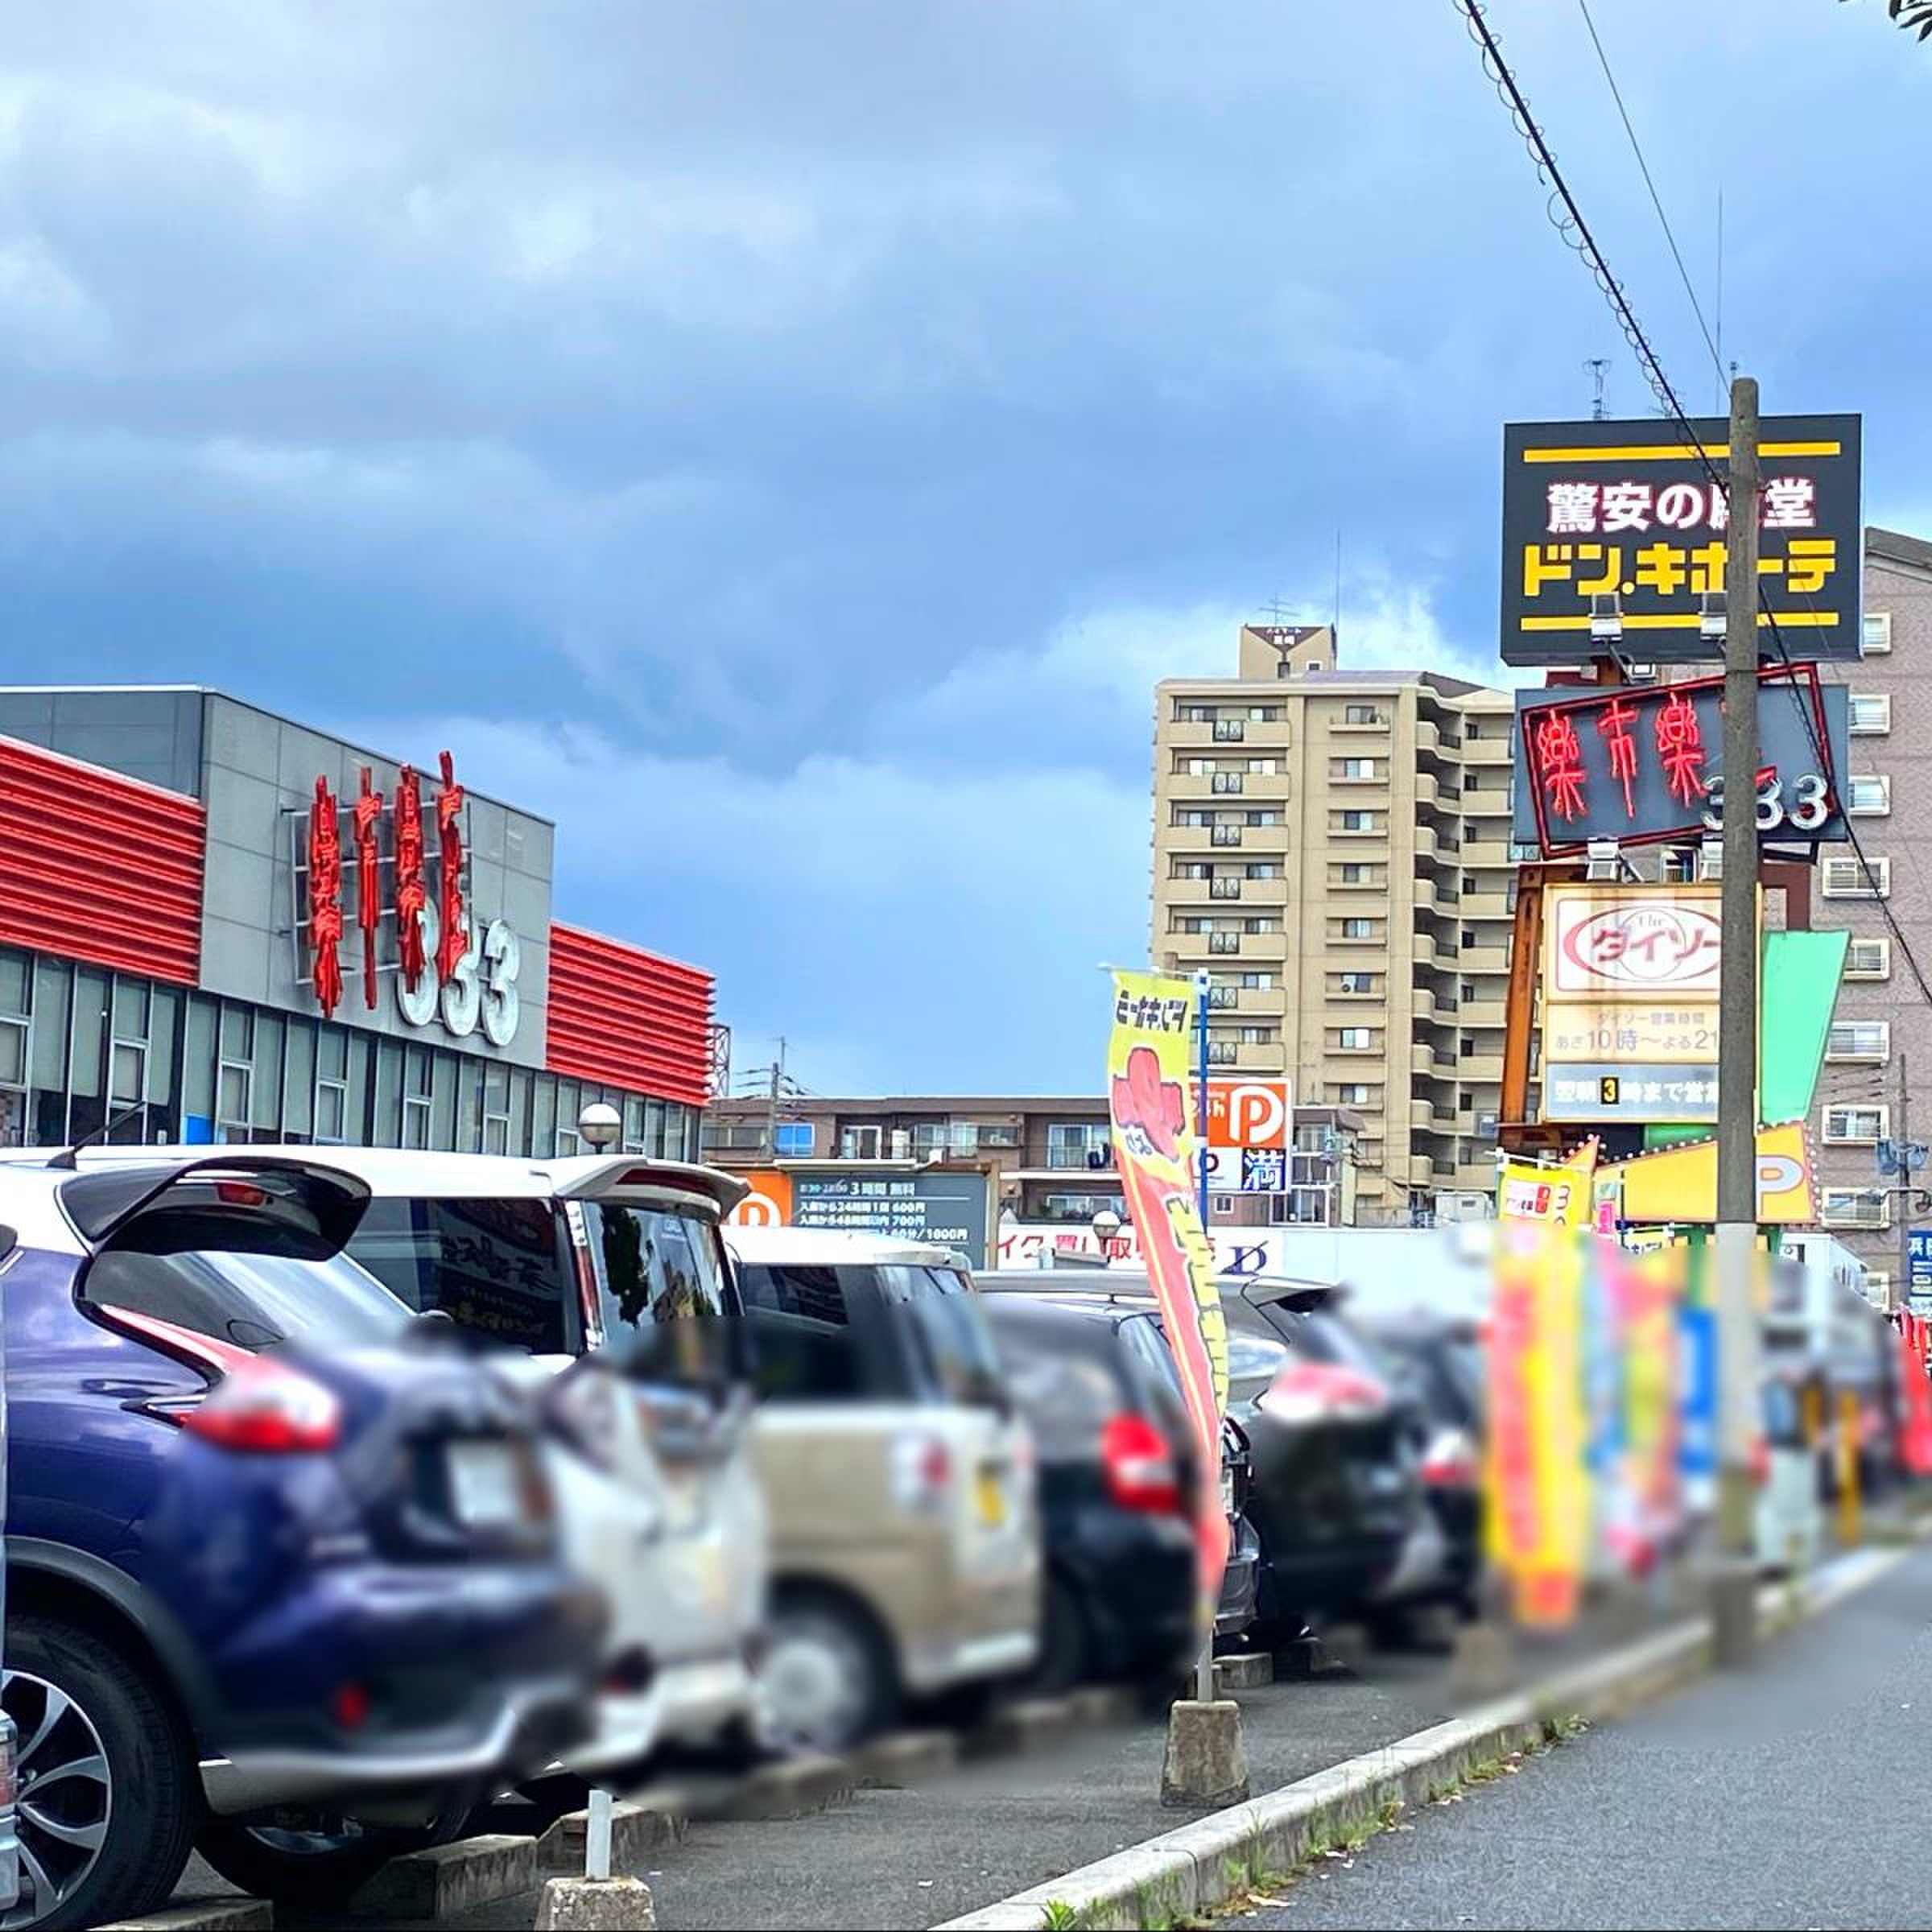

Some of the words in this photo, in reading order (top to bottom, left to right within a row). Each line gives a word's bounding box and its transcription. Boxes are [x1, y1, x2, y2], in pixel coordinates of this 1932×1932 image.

[1546, 478, 1816, 533] 驚安の堂
[1244, 1150, 1284, 1191] 満
